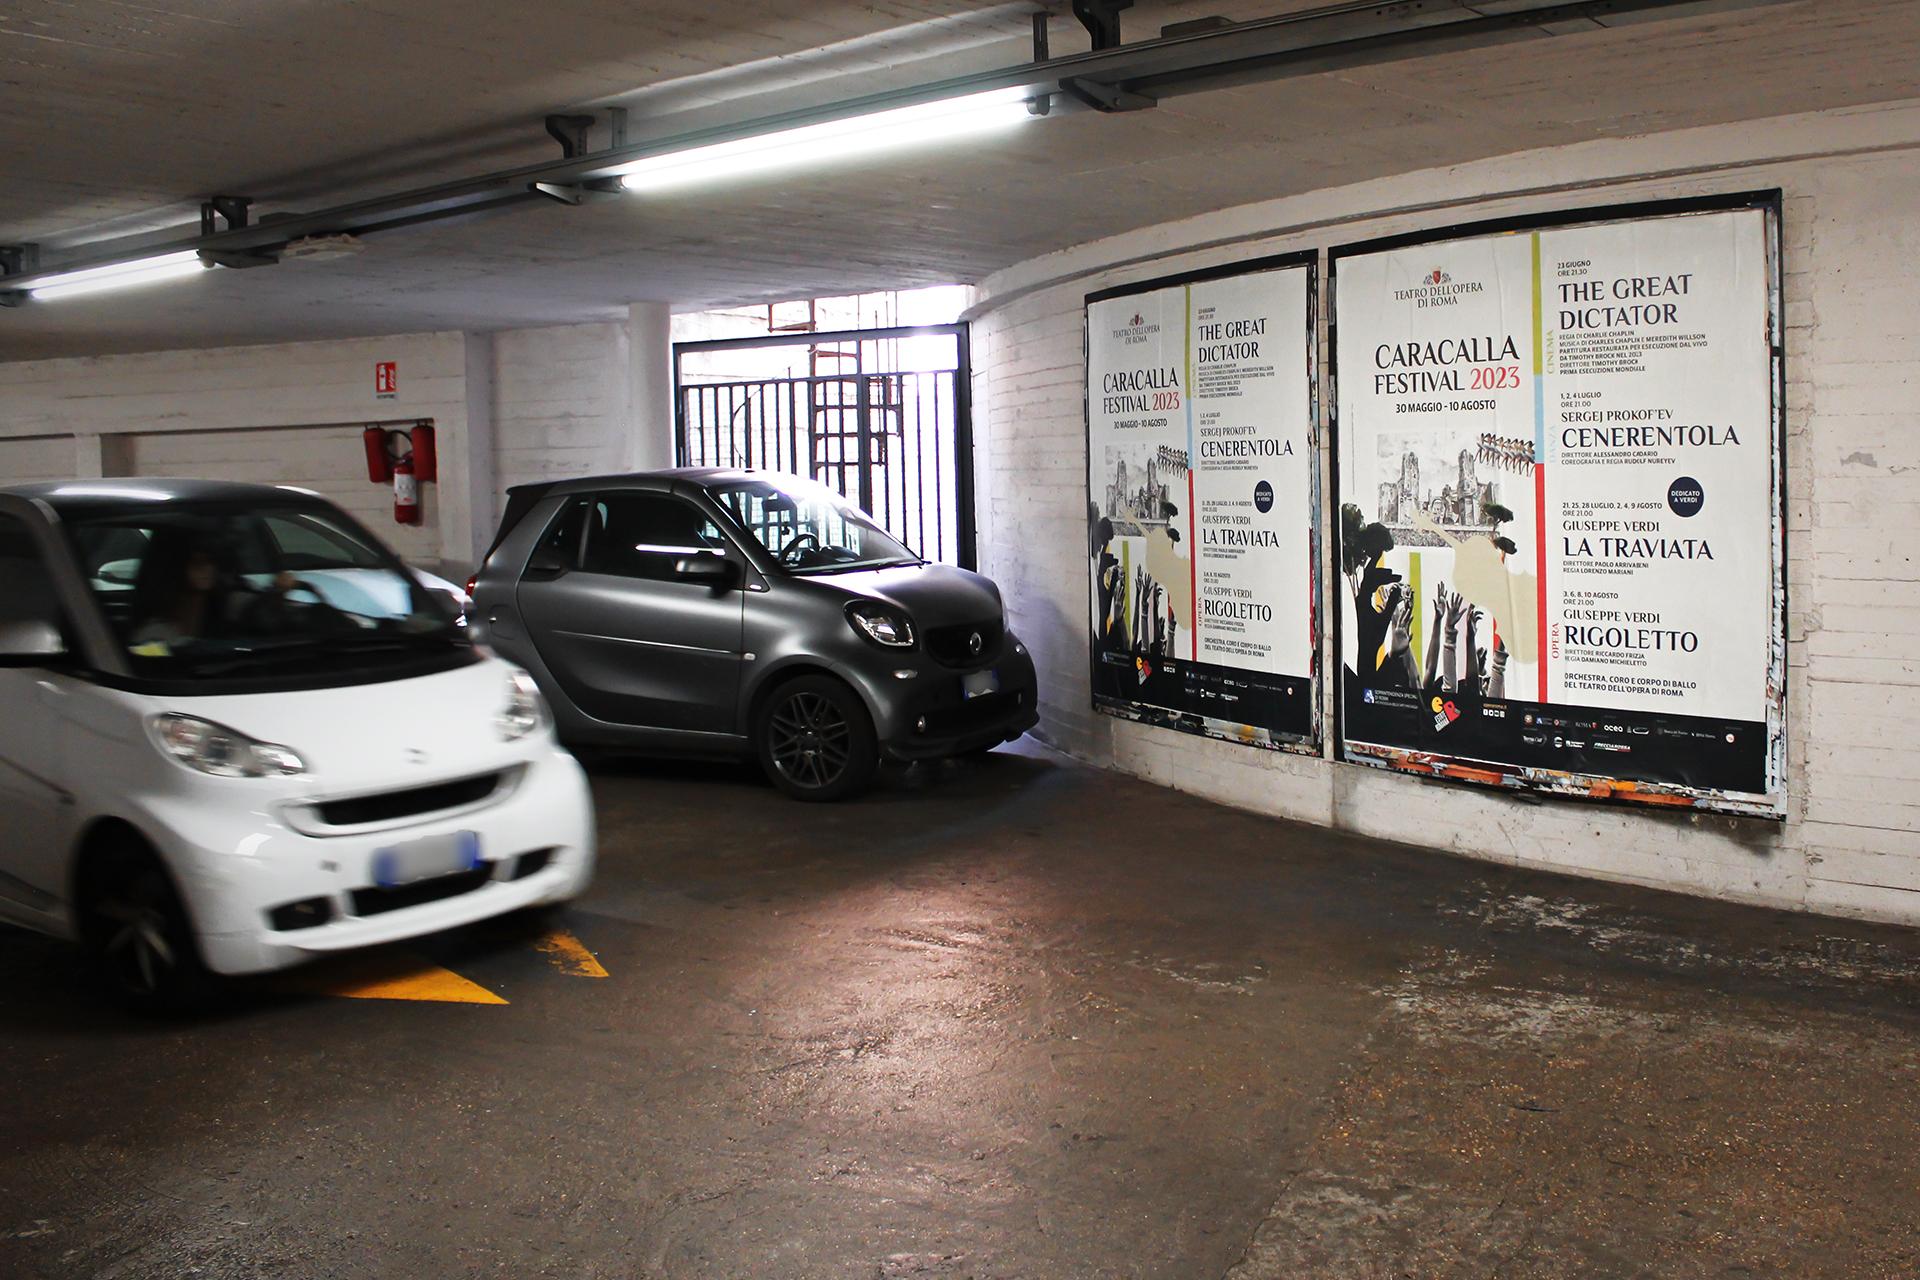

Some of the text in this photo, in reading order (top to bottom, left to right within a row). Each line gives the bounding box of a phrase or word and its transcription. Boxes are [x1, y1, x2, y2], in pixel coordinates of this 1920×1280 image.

[1395, 282, 1483, 300] TEATRO DELL'OPERA
[1558, 274, 1692, 303] THE GREAT
[1418, 296, 1457, 308] DI ROMA
[1560, 304, 1678, 330] DICTATOR
[1198, 318, 1266, 341] THE GREAT
[1199, 342, 1259, 363] DICTATOR
[1375, 336, 1520, 369] CARACALLA
[1104, 367, 1178, 393] CARACALLA
[1375, 367, 1520, 394] FESTIVAL 2023
[1104, 392, 1180, 414] FESTIVAL 2023
[1396, 403, 1406, 413] 30
[1408, 402, 1442, 412] MAGGIO
[1450, 401, 1459, 411] 10
[1461, 400, 1496, 410] AGOSTO
[1148, 419, 1167, 427] AGOSTO
[1561, 409, 1674, 423] SERGEJ PROKOF'EV
[1201, 426, 1256, 437] SERGEJ PROKOF'EV
[1562, 425, 1740, 448] CENERENTOLA
[1201, 439, 1293, 457] CENERENTOLA
[1202, 515, 1250, 525] GIUSEPPE VERDI
[1563, 520, 1660, 532] GIUSEPPE VERDI
[1203, 528, 1279, 547] LA TRAVIATA
[1563, 537, 1714, 560] LA TRAVIATA
[1204, 586, 1252, 598] GIUSEPPE VERDI
[1204, 599, 1271, 621] RIGOLETTO
[1564, 608, 1660, 623] GIUSEPPE VERDI
[1565, 625, 1698, 652] RIGOLETTO
[1580, 683, 1606, 691] TEATRO
[1608, 684, 1650, 694] DELL'OPERA
[1610, 675, 1629, 684] CORO
[1637, 678, 1661, 686] CORPO
[1672, 680, 1696, 689] BALLO
[1604, 724, 1623, 733] acea
